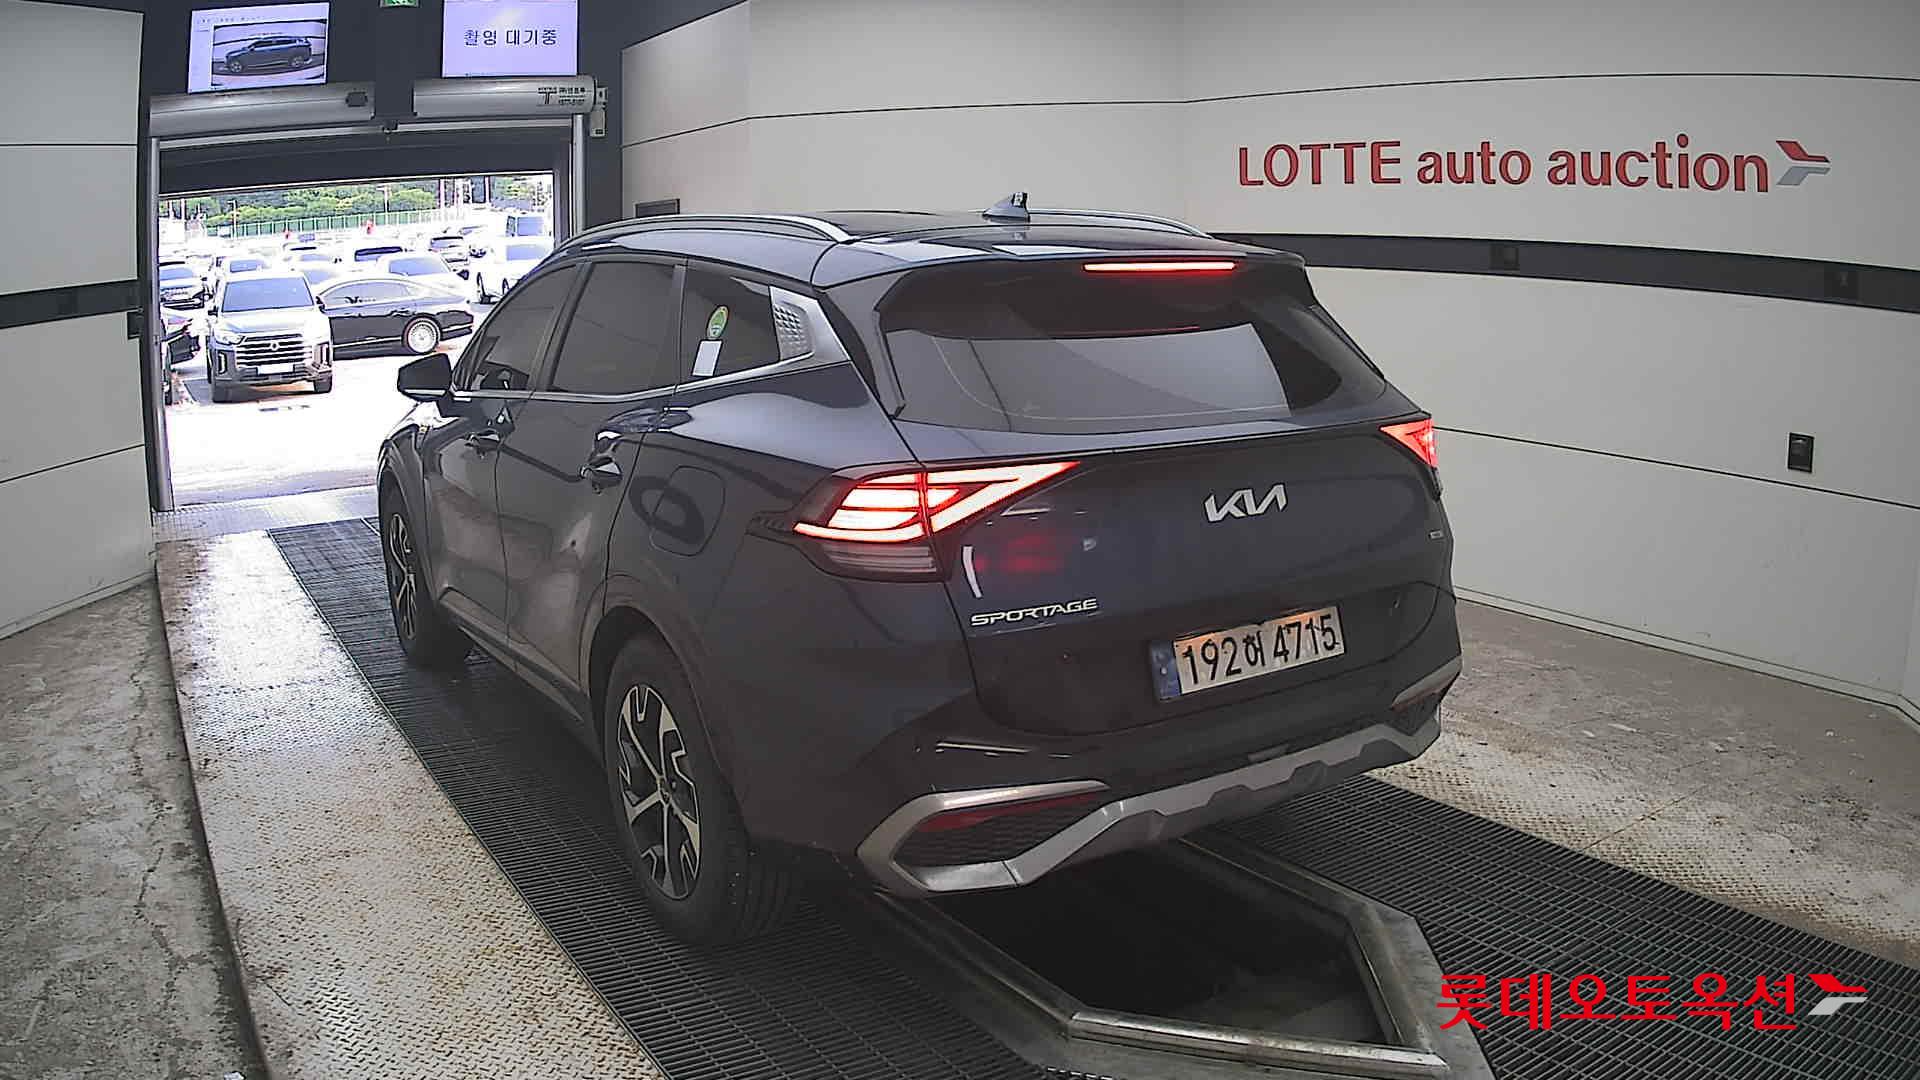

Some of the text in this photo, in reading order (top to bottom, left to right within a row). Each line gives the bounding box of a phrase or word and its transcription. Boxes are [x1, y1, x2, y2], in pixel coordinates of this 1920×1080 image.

[505, 29, 558, 47] 대기중
[1238, 132, 1770, 193] LOTTE auto auction
[1203, 483, 1288, 523] KIA
[970, 597, 1098, 627] SPORTAGE
[1182, 613, 1340, 685] 192허 4715
